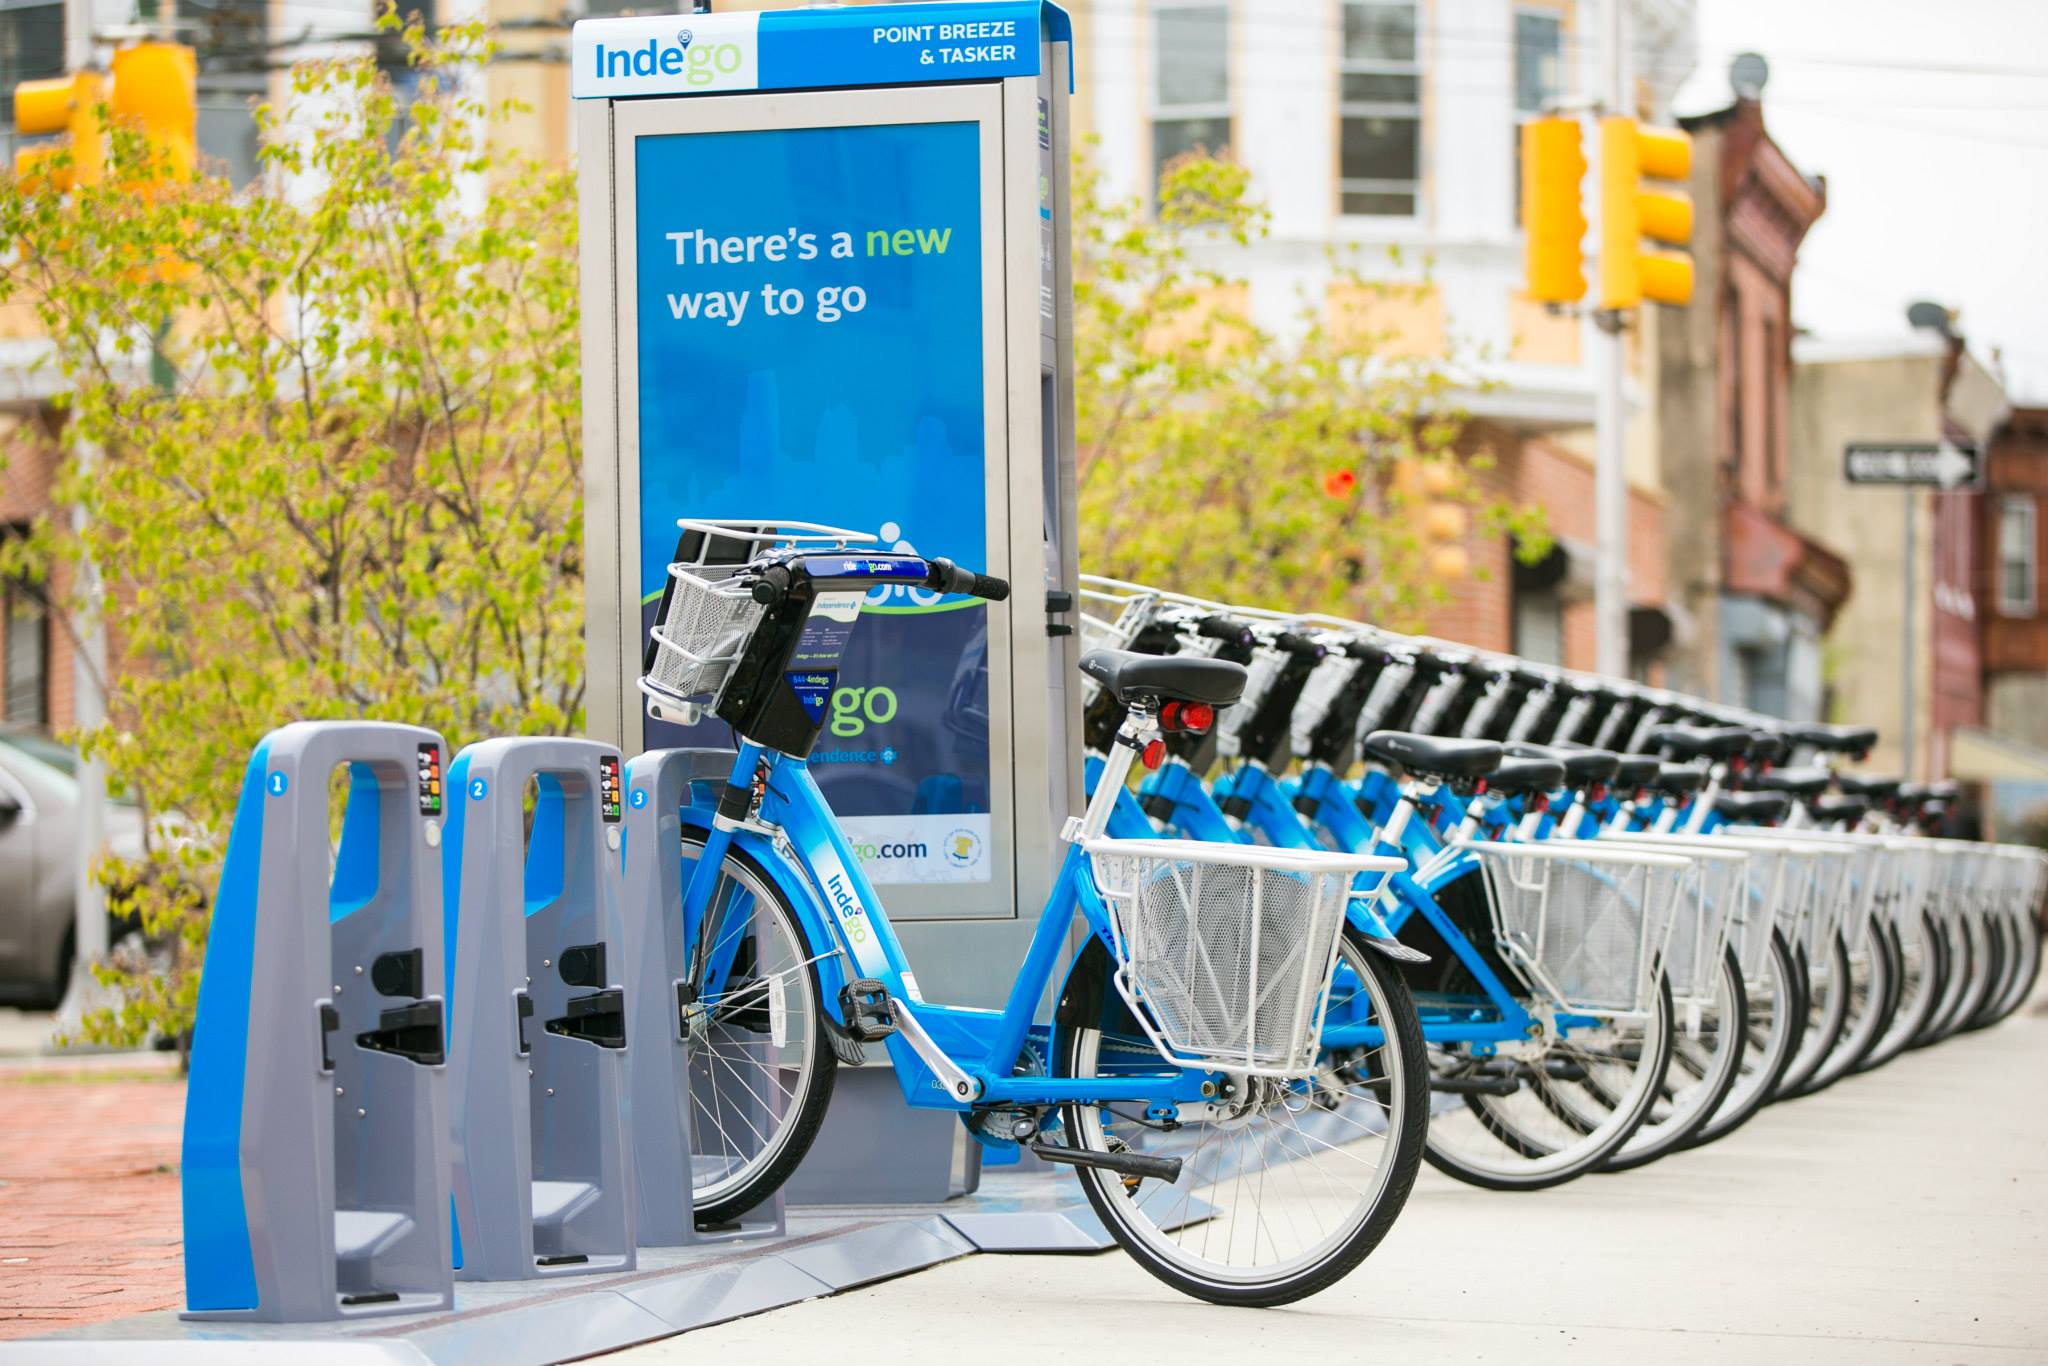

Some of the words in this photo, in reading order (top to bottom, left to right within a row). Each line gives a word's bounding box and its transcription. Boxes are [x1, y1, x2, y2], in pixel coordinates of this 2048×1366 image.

[873, 25, 935, 44] POINT
[939, 21, 1016, 40] BREEZE
[596, 38, 742, 86] Indego
[919, 49, 935, 65] &
[939, 45, 1016, 64] TASKER
[665, 227, 818, 265] There’s
[830, 231, 855, 259] a
[866, 227, 952, 257] new
[666, 290, 750, 327] way
[760, 283, 805, 316] to
[816, 284, 867, 323] go
[272, 777, 282, 792] 1
[474, 782, 483, 796] 2
[634, 791, 644, 805] 3
[828, 874, 867, 944] Indego
